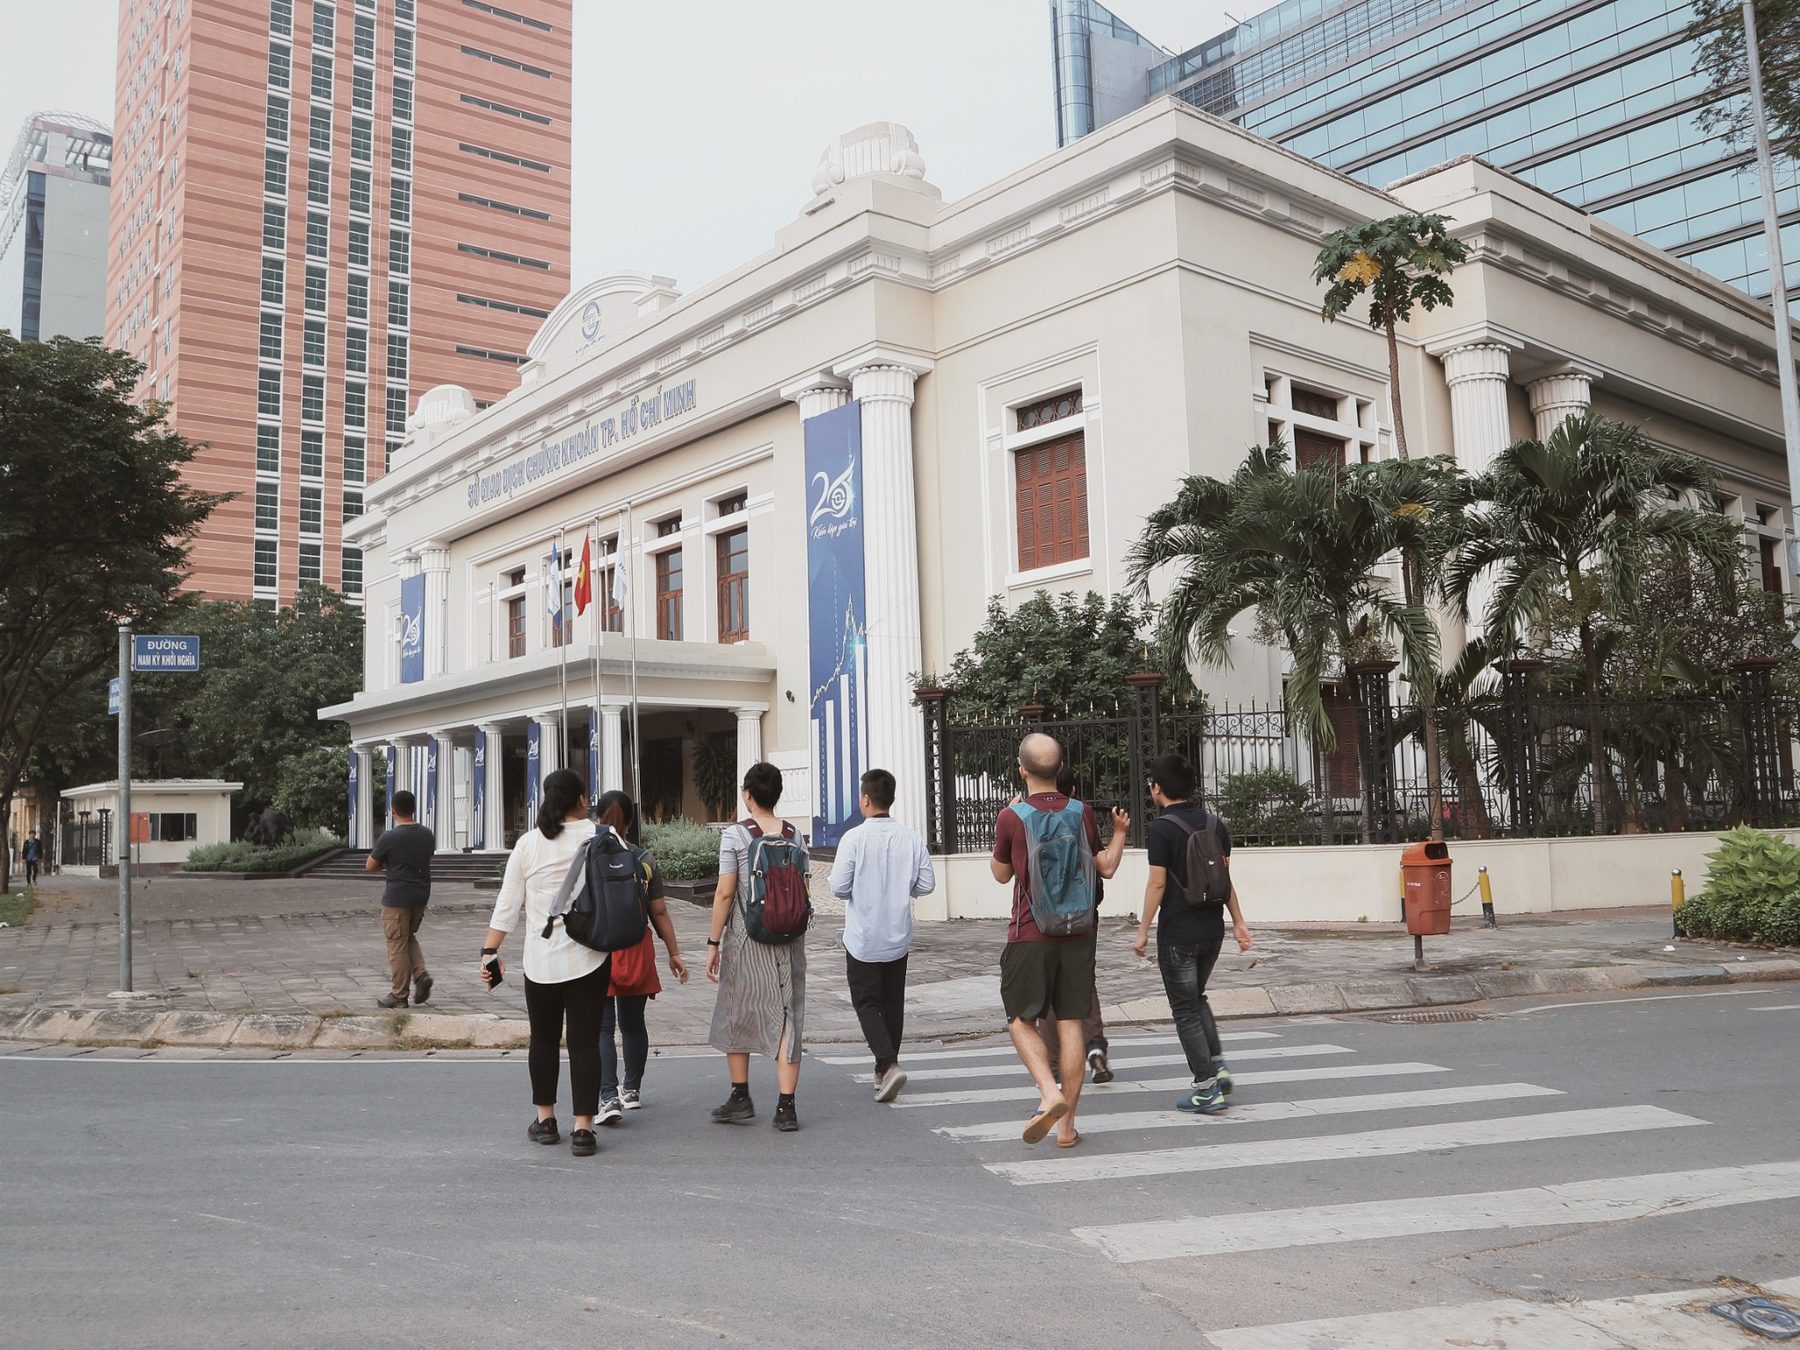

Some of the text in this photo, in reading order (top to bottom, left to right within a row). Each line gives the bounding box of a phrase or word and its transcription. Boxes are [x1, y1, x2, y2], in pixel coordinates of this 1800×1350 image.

[468, 378, 697, 508] SỞ GIAO DỊCH CHỨNG KHOÁN TP. HỒ CHÍ MINH
[147, 639, 188, 650] ĐƯỜNG
[137, 654, 151, 666] NAM
